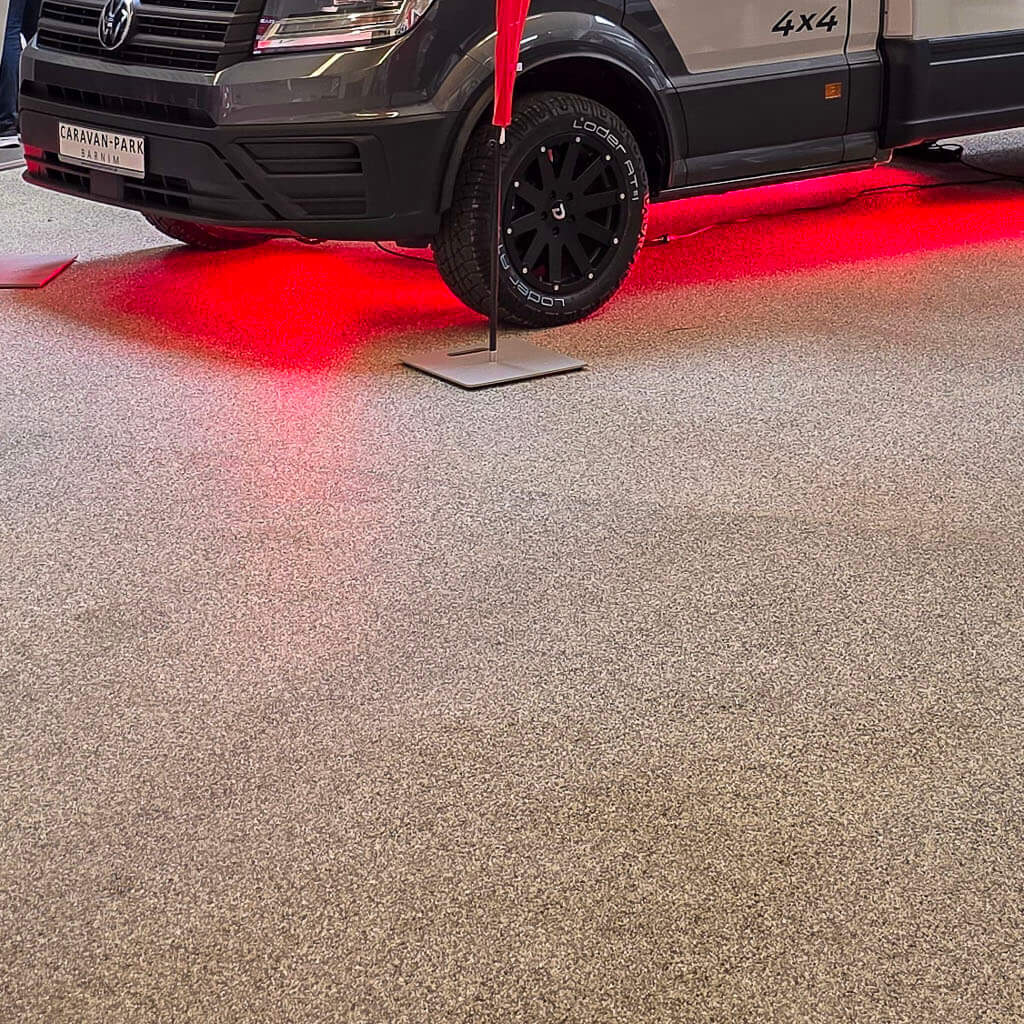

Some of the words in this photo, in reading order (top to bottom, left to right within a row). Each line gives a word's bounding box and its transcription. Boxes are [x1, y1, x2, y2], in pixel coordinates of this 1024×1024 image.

[771, 6, 838, 37] 4x4
[60, 125, 144, 155] CARAVAN-PARK
[80, 148, 120, 164] BARNIM
